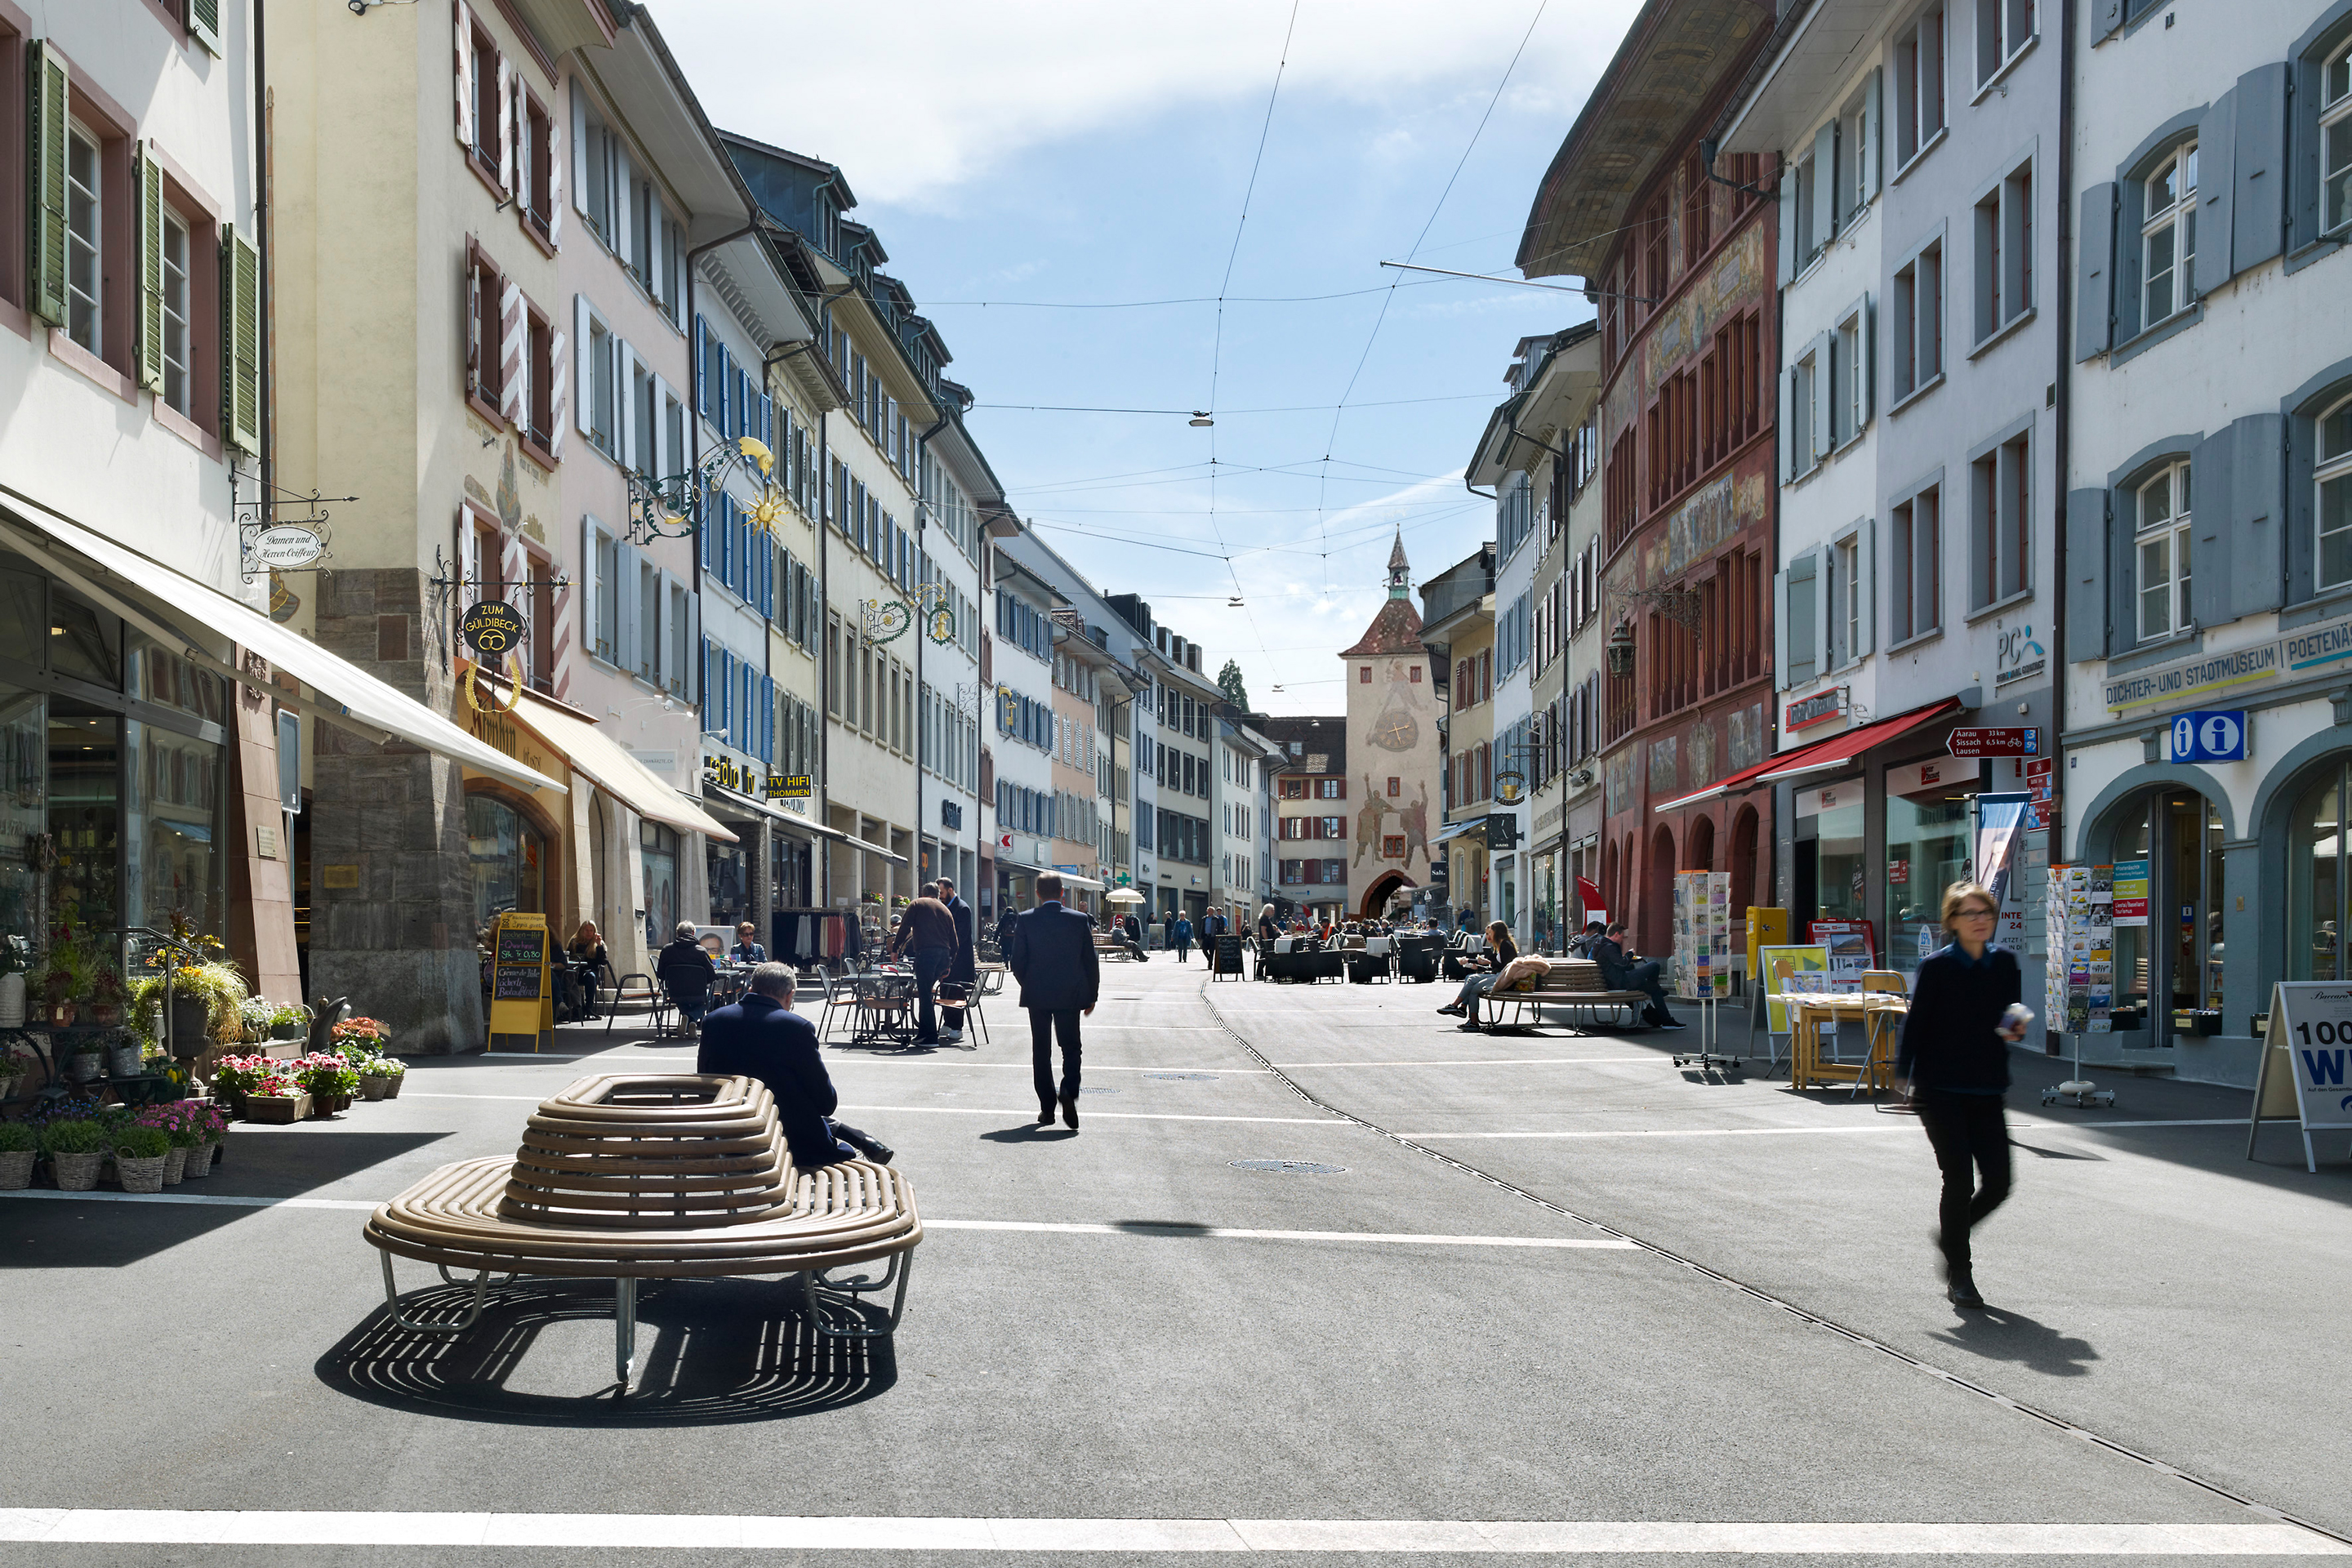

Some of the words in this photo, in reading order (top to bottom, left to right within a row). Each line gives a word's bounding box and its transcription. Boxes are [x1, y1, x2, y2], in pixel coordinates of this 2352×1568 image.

[265, 535, 294, 545] Damen
[295, 535, 312, 544] und
[261, 548, 316, 559] Herren-Coiffeur
[481, 605, 504, 615] ZUM
[466, 617, 519, 633] GÜLDIBECK
[1998, 626, 2020, 669] PC
[2186, 647, 2274, 686] STADTMUSEUM
[2289, 622, 2352, 661] POETENÄ
[2028, 729, 2036, 739] 3
[704, 755, 739, 789] radio
[742, 765, 755, 794] tv
[768, 777, 782, 786] TV
[787, 776, 809, 786] HIFI
[768, 789, 809, 797] THOMMEN
[2310, 991, 2349, 1000] Baccara
